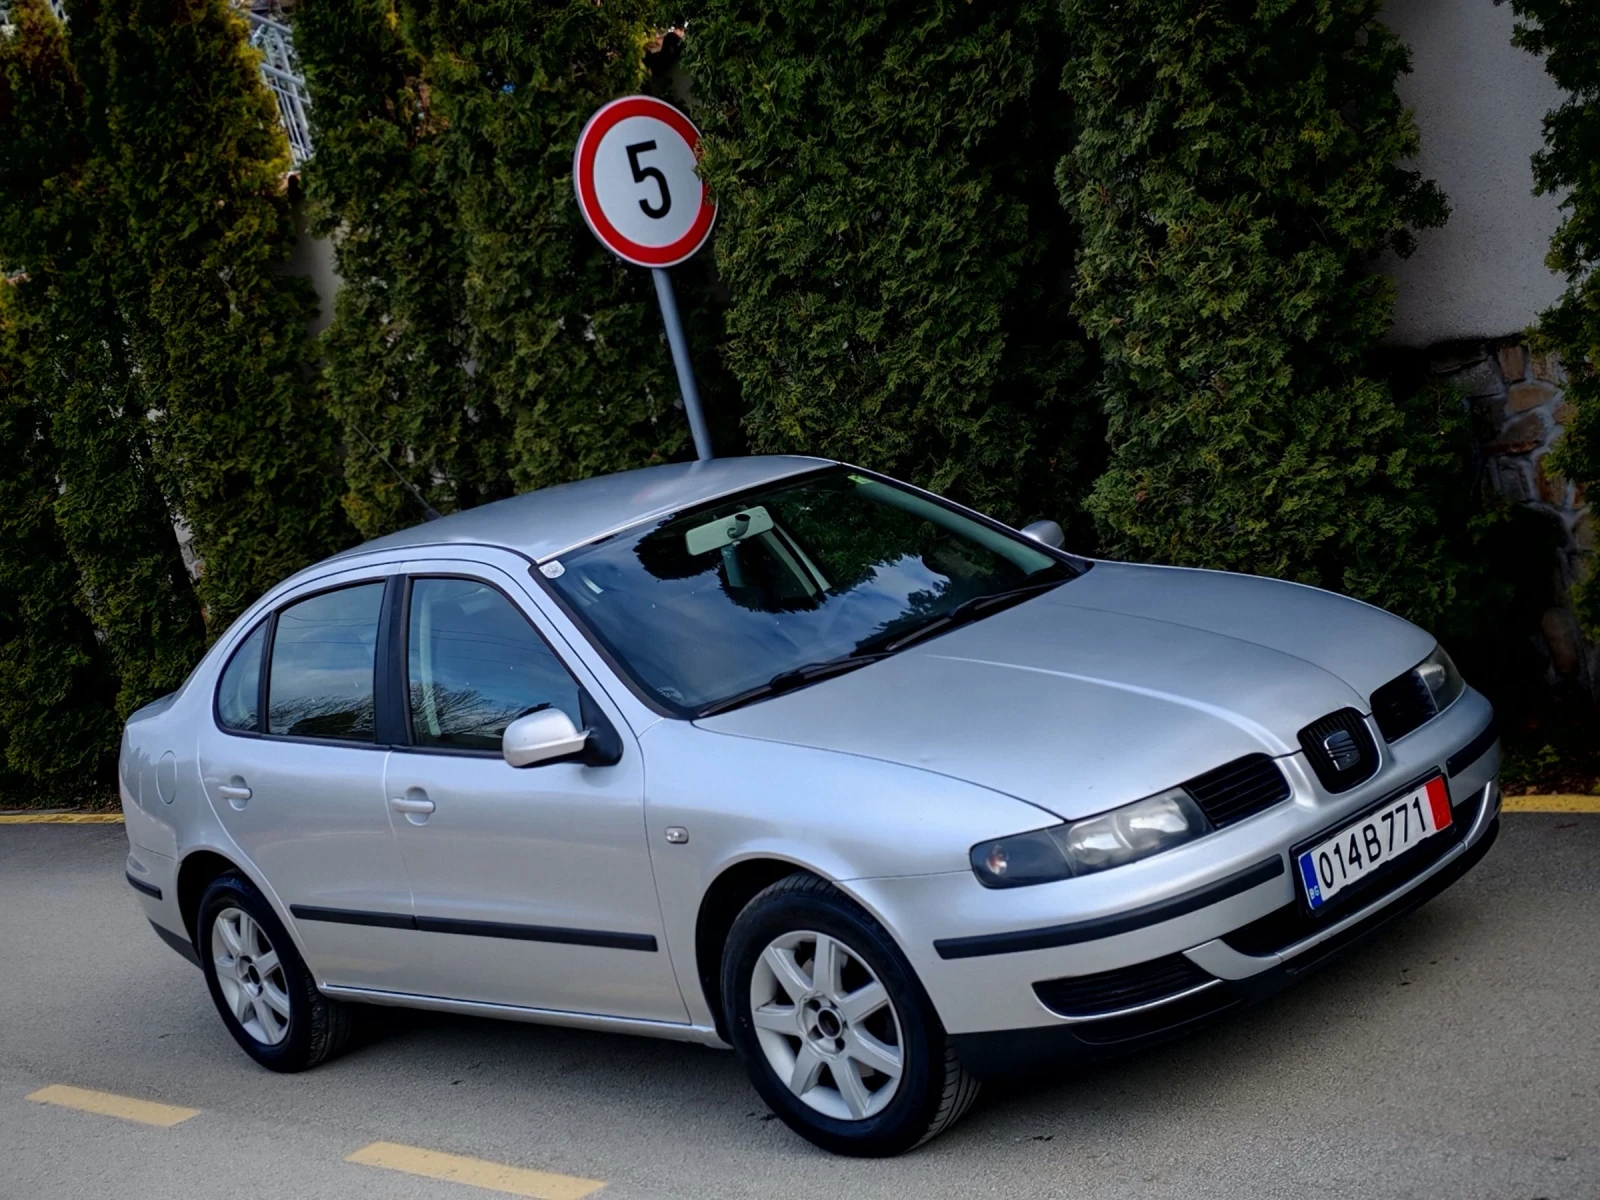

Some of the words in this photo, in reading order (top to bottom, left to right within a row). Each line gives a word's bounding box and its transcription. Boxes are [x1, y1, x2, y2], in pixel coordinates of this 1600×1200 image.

[626, 140, 672, 219] 5
[1319, 796, 1426, 889] 014B771
[1309, 885, 1320, 900] BG
